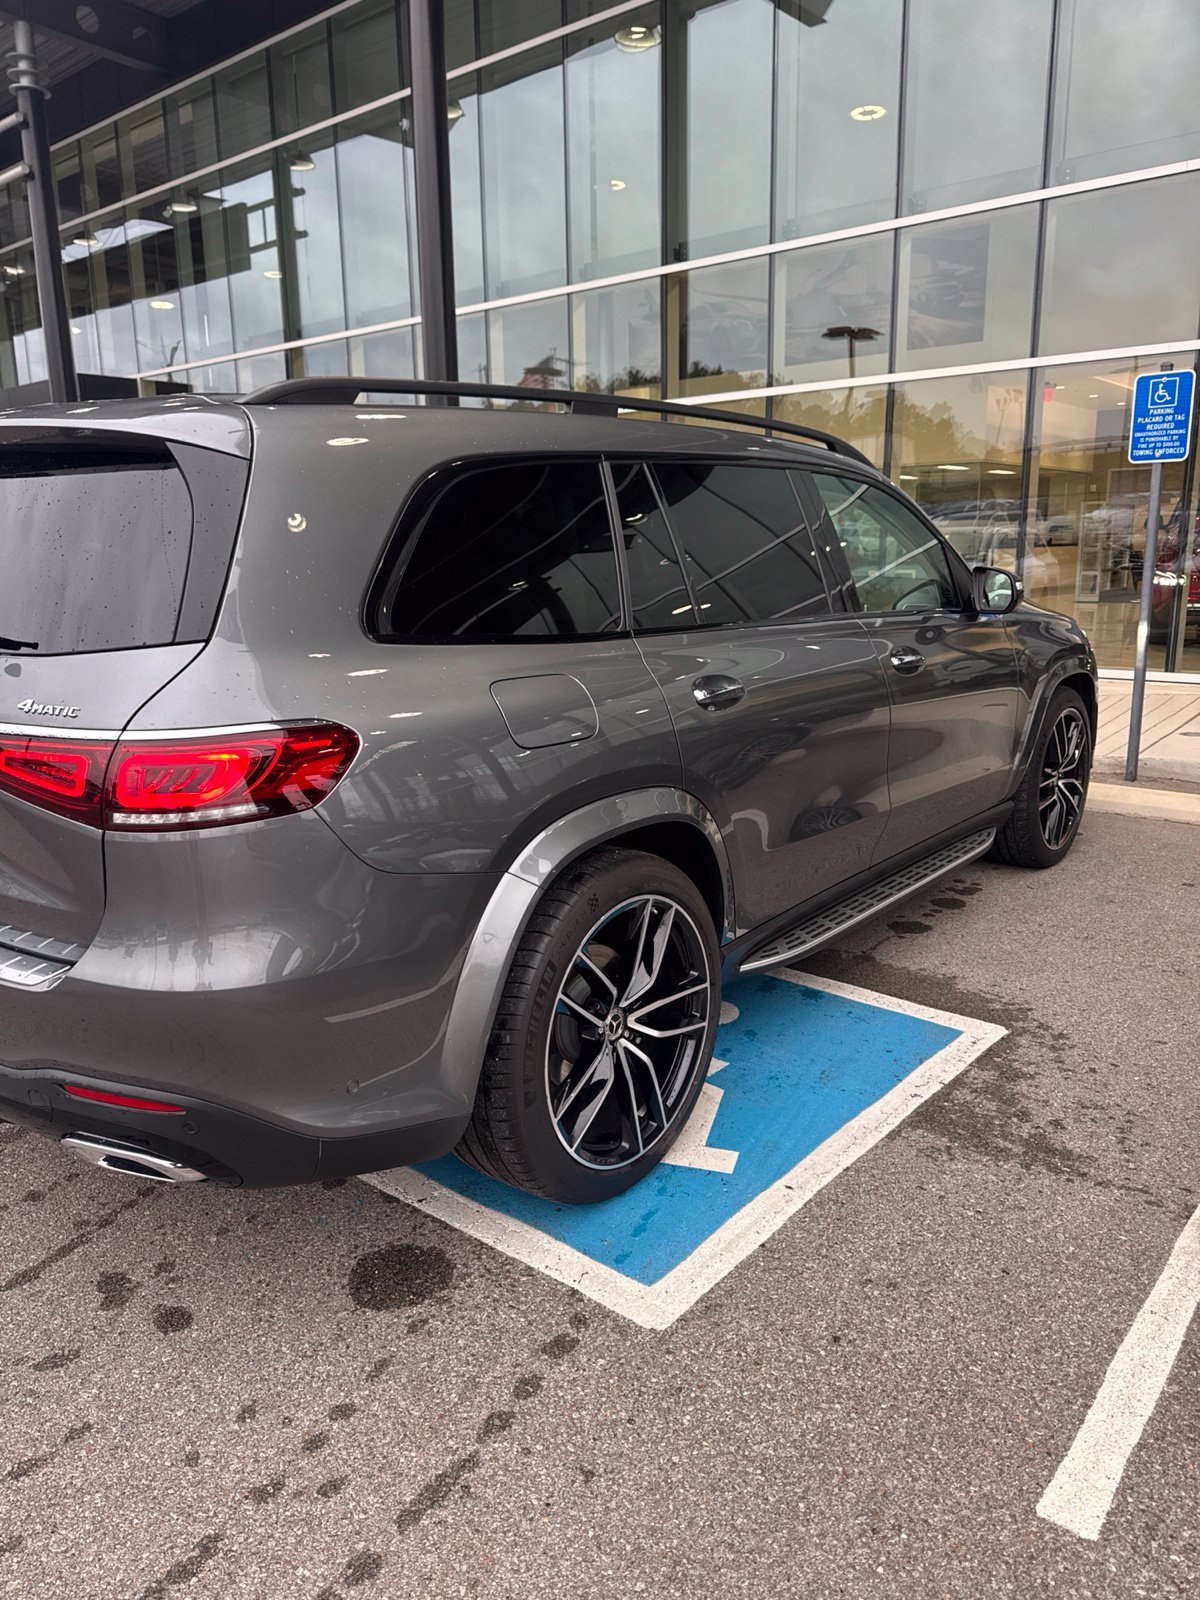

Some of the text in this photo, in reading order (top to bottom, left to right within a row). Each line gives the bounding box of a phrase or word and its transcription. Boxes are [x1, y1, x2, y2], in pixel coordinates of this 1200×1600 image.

[1137, 416, 1163, 424] PLACARD
[1146, 422, 1175, 430] REQUIRED
[1155, 447, 1184, 455] ENFORCED
[17, 698, 81, 718] 4MATIC
